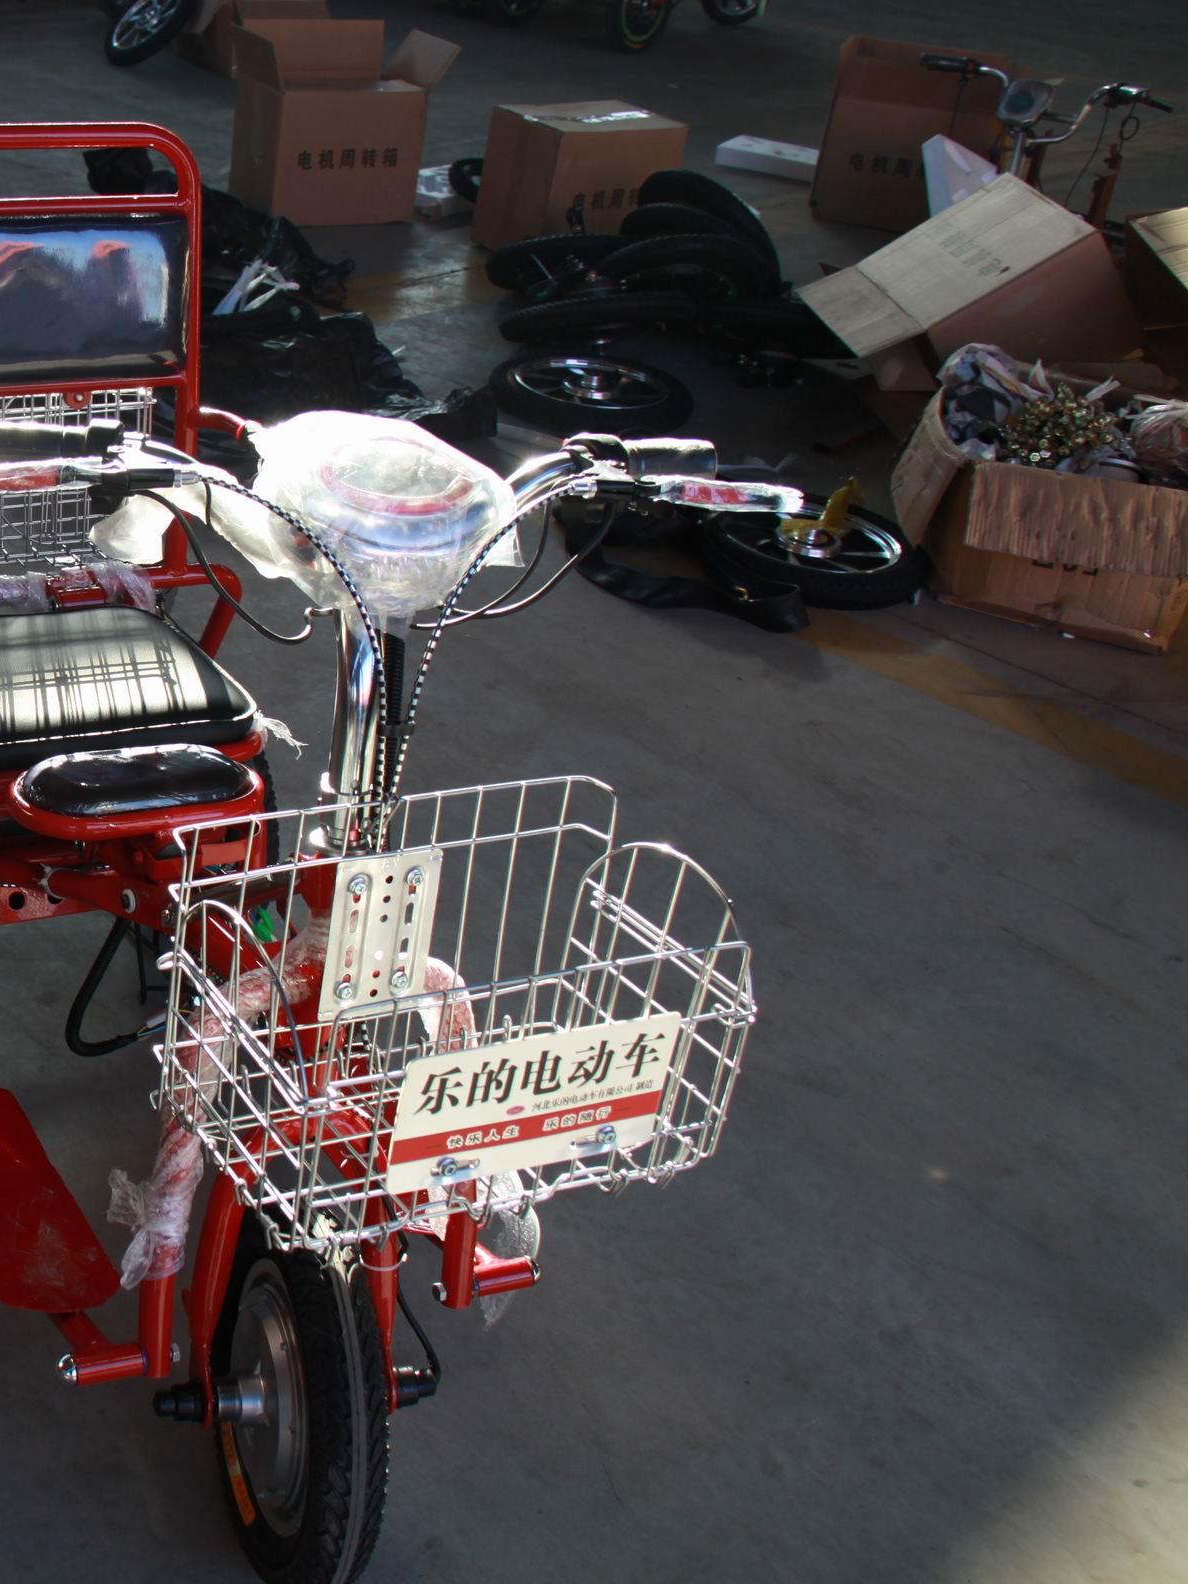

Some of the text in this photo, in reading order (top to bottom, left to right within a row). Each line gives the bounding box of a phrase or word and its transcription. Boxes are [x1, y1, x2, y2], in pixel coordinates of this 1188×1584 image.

[297, 147, 399, 170] 电机周转箱
[848, 154, 923, 178] 电机周
[414, 1033, 665, 1115] 乐的电动车
[531, 1084, 633, 1111] 河北乐的电动车有限公司
[635, 1079, 653, 1091] 制造
[447, 1125, 520, 1149] 快乐人生
[543, 1106, 611, 1131] 乐的随行
